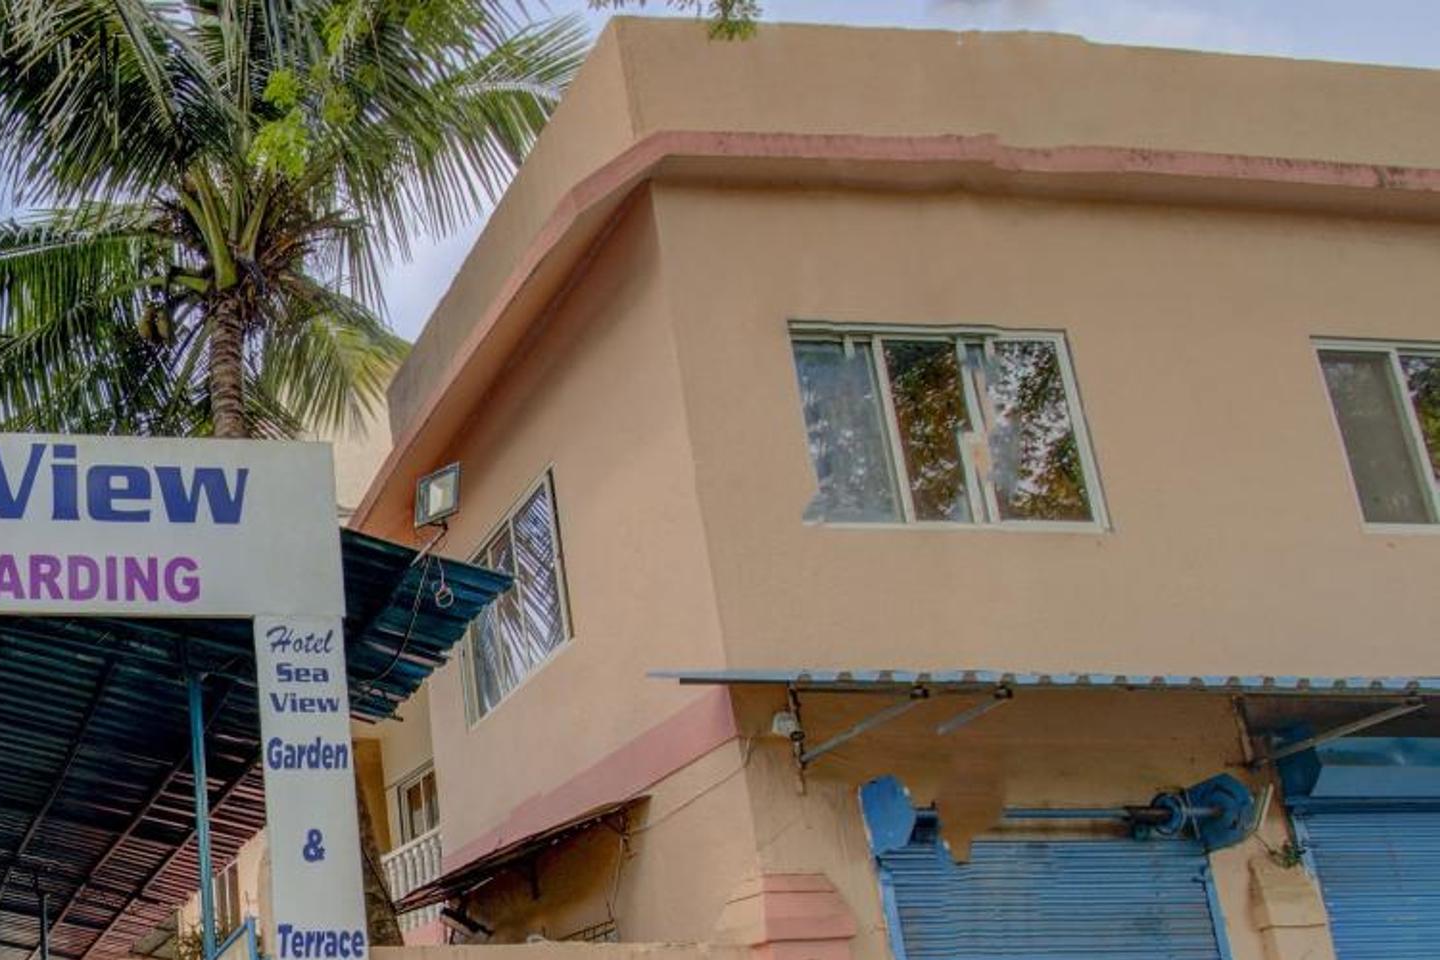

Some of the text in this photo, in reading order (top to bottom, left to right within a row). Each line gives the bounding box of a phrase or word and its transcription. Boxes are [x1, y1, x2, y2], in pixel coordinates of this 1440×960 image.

[266, 625, 333, 654] Hotel
[275, 662, 330, 684] Sea
[268, 692, 340, 714] View
[266, 736, 349, 771] Garden
[302, 828, 326, 863] &
[277, 923, 366, 960] Terrace
